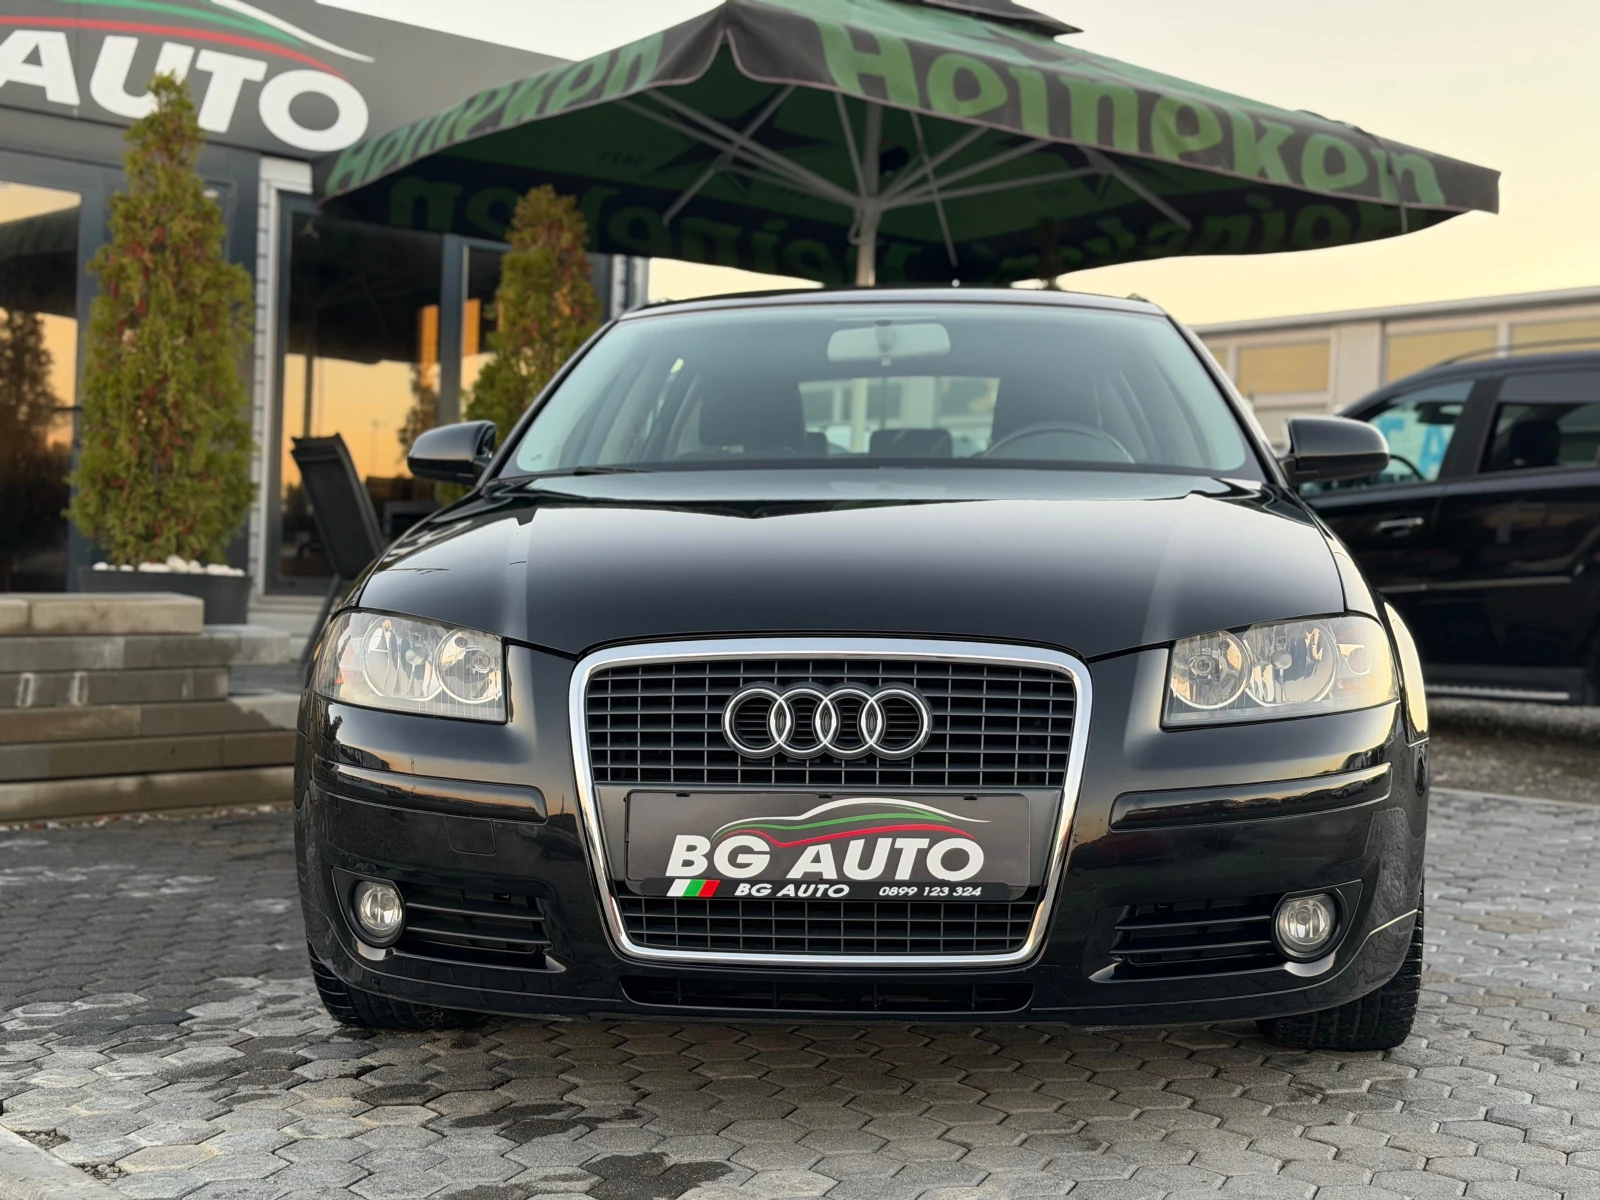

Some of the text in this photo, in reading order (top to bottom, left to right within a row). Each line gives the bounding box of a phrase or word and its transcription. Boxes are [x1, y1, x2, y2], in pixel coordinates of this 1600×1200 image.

[0, 29, 369, 151] AUTO
[666, 835, 985, 881] BG AUTO
[734, 883, 983, 898] BG AUTO 0899 123 324
